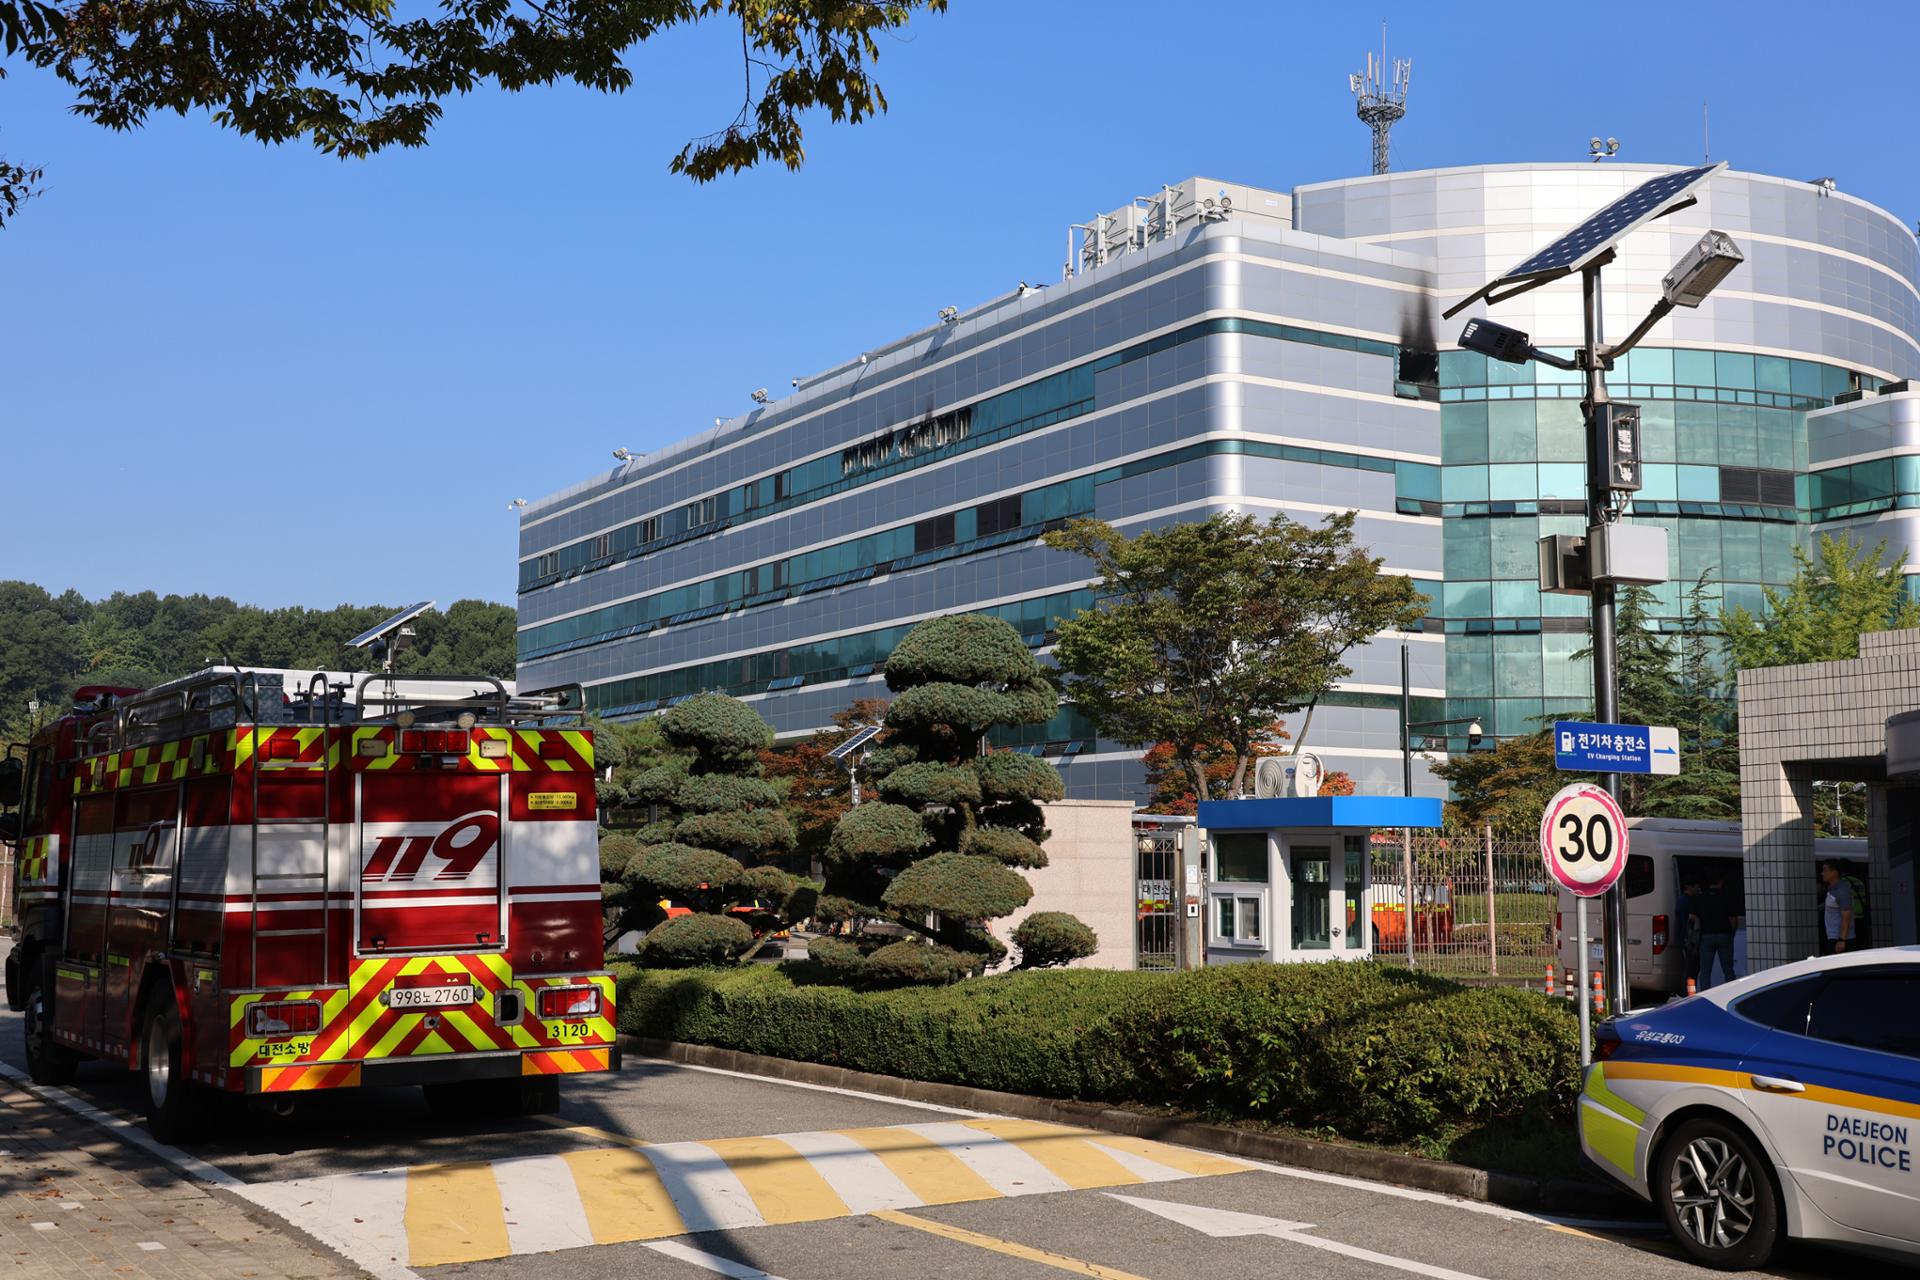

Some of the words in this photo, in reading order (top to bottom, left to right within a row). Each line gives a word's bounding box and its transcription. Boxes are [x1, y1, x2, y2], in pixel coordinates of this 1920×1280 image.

[1578, 733, 1647, 752] 전기차충전소
[1587, 752, 1594, 760] EV
[1595, 753, 1621, 762] Charging
[362, 811, 498, 883] 119
[1559, 813, 1613, 863] 30
[395, 990, 431, 1005] 998노
[434, 988, 469, 1003] 2760
[552, 1023, 589, 1038] 3120
[258, 1042, 310, 1057] 대전소방
[1826, 1113, 1908, 1145] DAEJEON
[1823, 1134, 1911, 1172] POLICE
